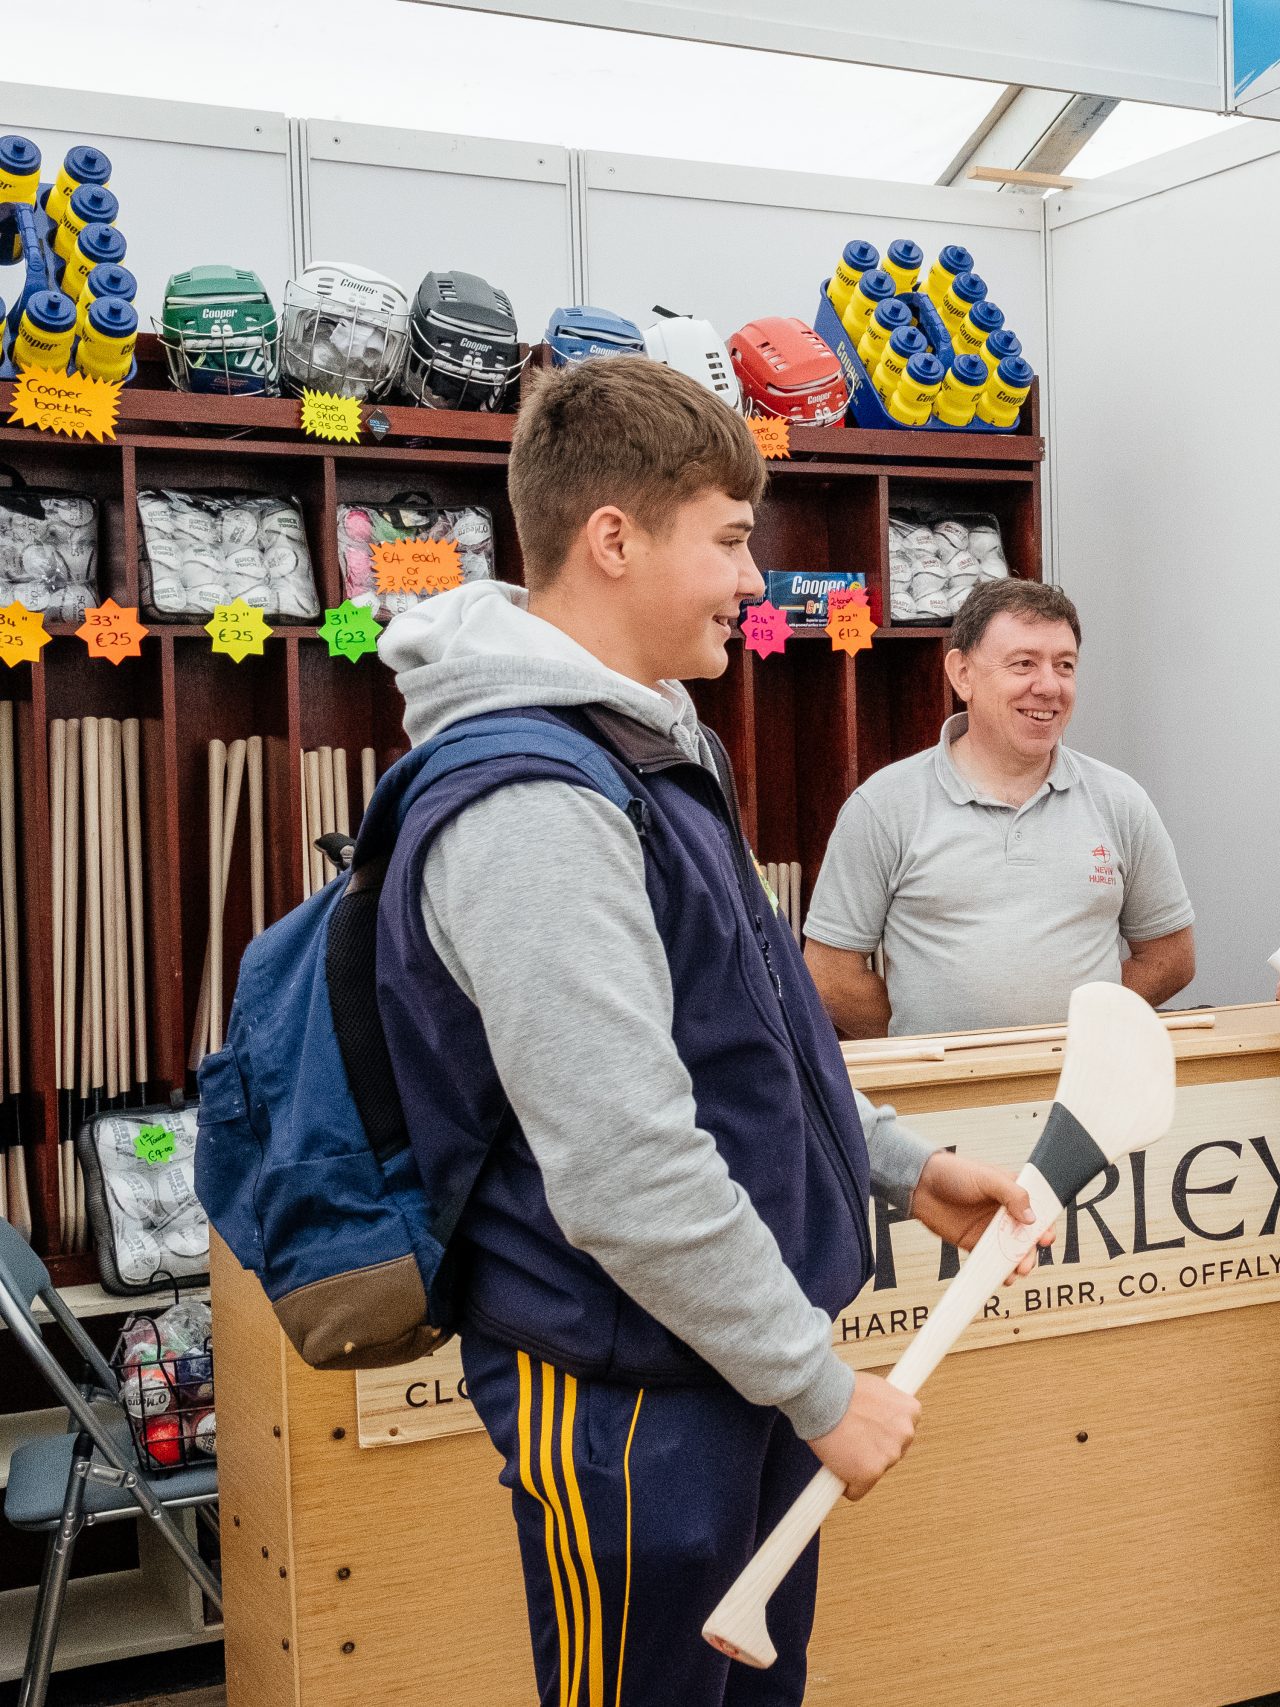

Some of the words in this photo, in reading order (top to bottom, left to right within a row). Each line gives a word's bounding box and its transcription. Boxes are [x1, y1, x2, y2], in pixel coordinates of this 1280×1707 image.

[340, 278, 378, 296] Cooper
[202, 308, 238, 320] Cooper
[460, 338, 493, 353] Cooper
[26, 379, 82, 399] Cooper
[807, 391, 832, 405] Cooper
[34, 398, 92, 417] bottles
[308, 399, 339, 412] Cooper
[757, 432, 778, 441] 100
[412, 552, 441, 563] each
[406, 567, 420, 576] or
[387, 576, 395, 586] 3
[402, 576, 419, 587] for
[90, 615, 120, 626] 33"
[218, 612, 249, 623] 32"
[330, 611, 359, 625] 31"
[96, 632, 131, 647] €25
[219, 629, 253, 643] €25
[335, 629, 366, 650] €23
[751, 629, 773, 641] €13
[839, 629, 860, 641] €12
[841, 1295, 1010, 1342] HARBR,
[1025, 1281, 1104, 1313] BIRR,
[1118, 1272, 1166, 1298] CO.
